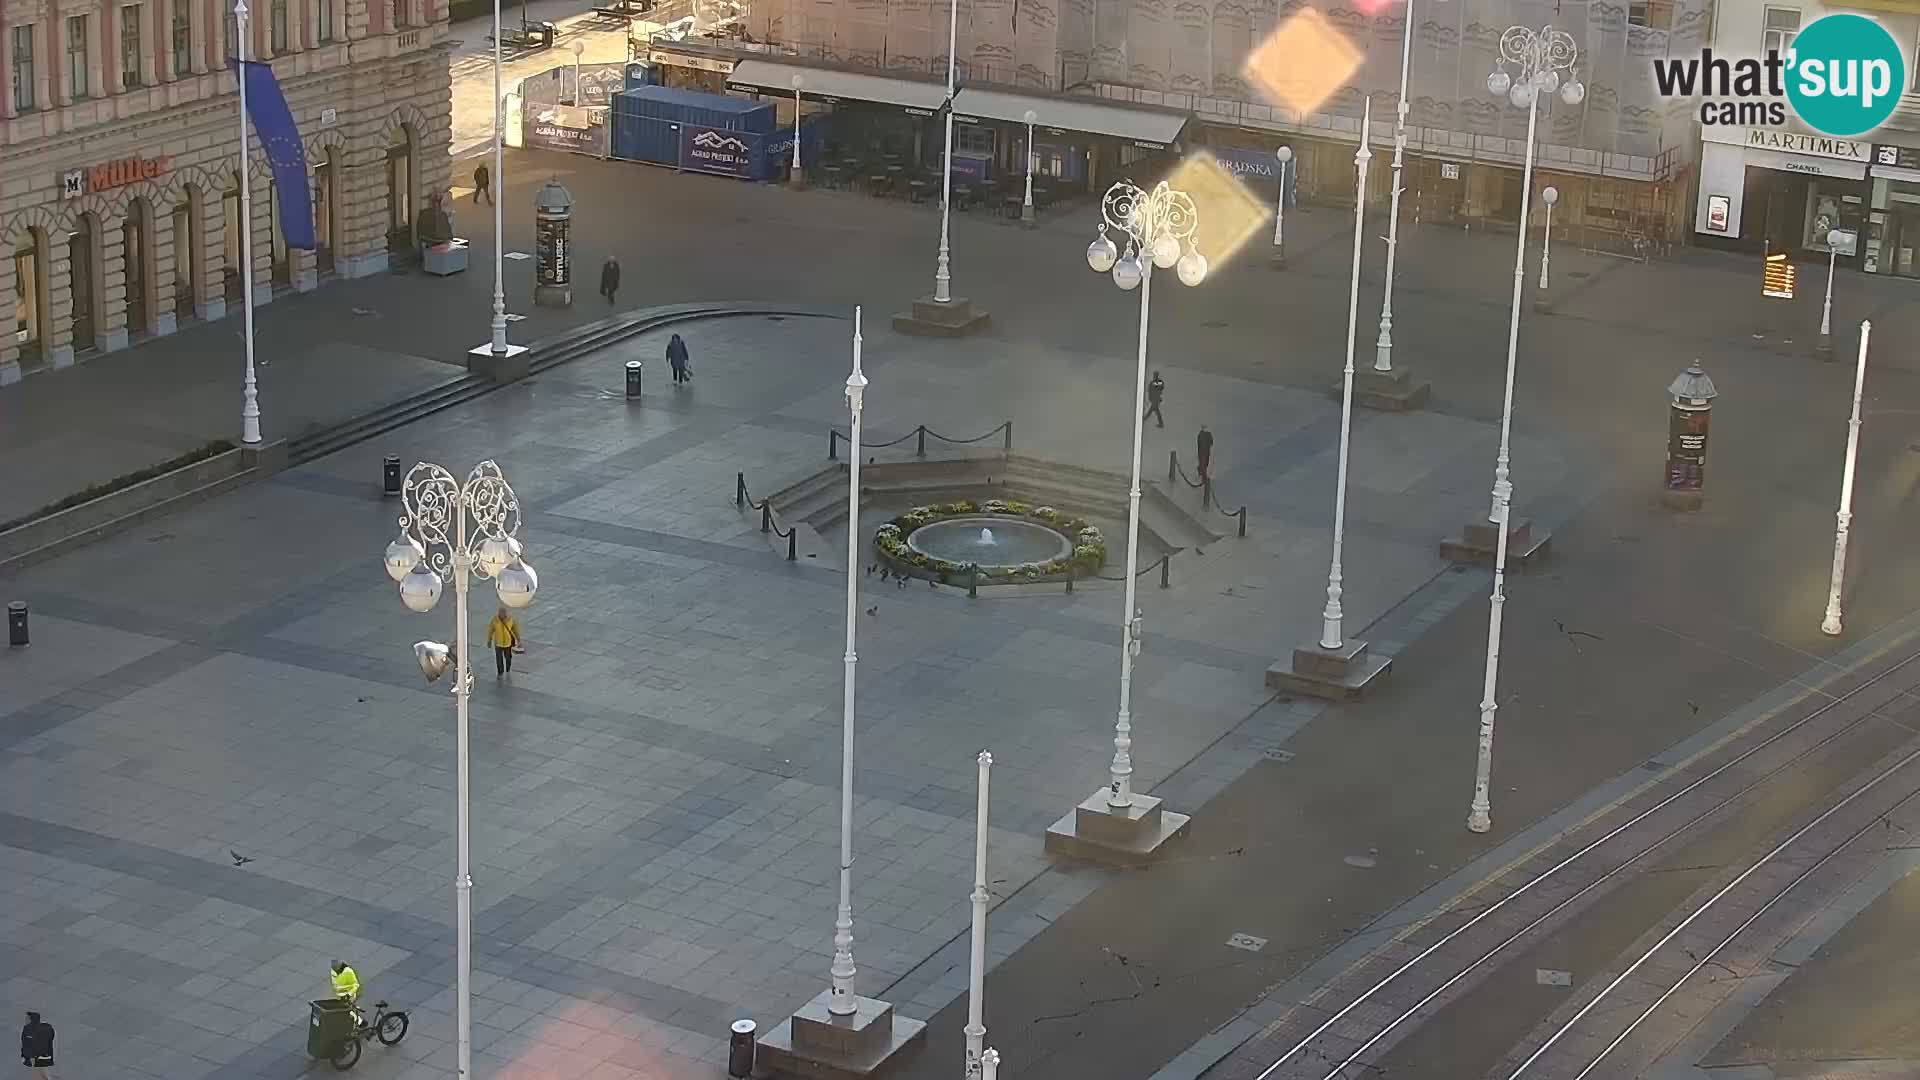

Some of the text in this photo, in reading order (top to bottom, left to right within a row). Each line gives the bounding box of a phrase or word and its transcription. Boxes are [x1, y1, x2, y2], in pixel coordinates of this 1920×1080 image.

[1750, 130, 1860, 157] MARTIMEX
[1216, 159, 1272, 176] GRADSKA
[1785, 162, 1823, 174] CHANEL
